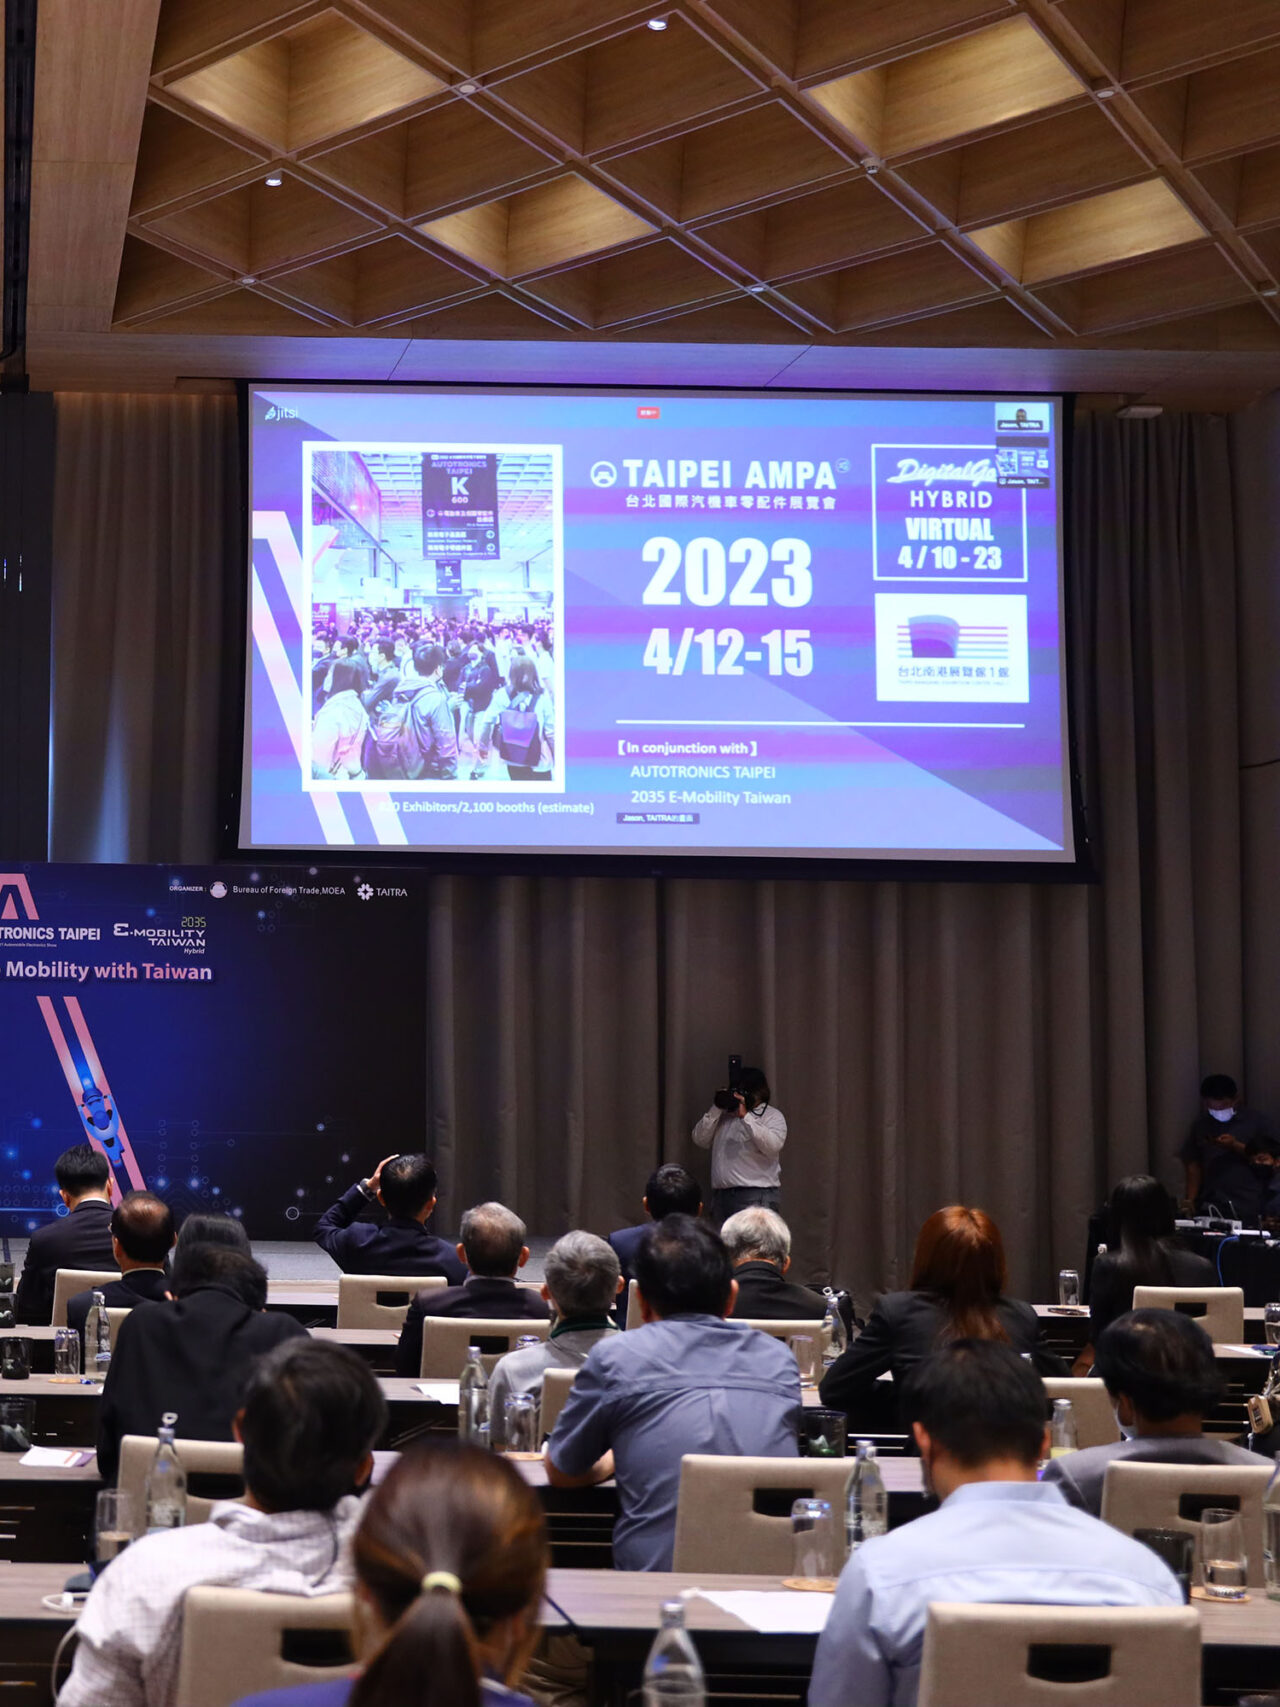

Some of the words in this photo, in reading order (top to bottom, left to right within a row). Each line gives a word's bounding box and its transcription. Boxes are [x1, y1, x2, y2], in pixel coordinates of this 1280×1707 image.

[276, 406, 299, 420] jitsi
[623, 458, 731, 488] TAIPEI
[745, 460, 837, 490] AMPA
[451, 476, 469, 495] K
[910, 490, 992, 508] HYBRID
[905, 517, 994, 541] VIRTUAL
[642, 536, 813, 608] 2023
[643, 628, 813, 677] 4/12-15
[642, 742, 716, 756] conjunction
[630, 766, 730, 778] AUTOTRONICS
[733, 766, 775, 779] TAIPEI
[631, 790, 665, 803] 2035
[669, 790, 740, 806] E-Mobility
[743, 792, 791, 804] Taiwan
[402, 801, 493, 814] Exhibitors/2,100
[496, 802, 535, 813] booths
[538, 802, 594, 815] (estimate)
[233, 886, 259, 894] Bureau
[260, 886, 268, 894] of
[269, 886, 297, 896] Foreign
[376, 888, 408, 896] TAITRA
[181, 916, 206, 927] 2035
[58, 927, 100, 940] TAIPEI
[148, 938, 205, 946] TAIWAN
[6, 961, 89, 982] Mobility
[93, 962, 138, 979] with
[142, 963, 212, 980] Taiwan
